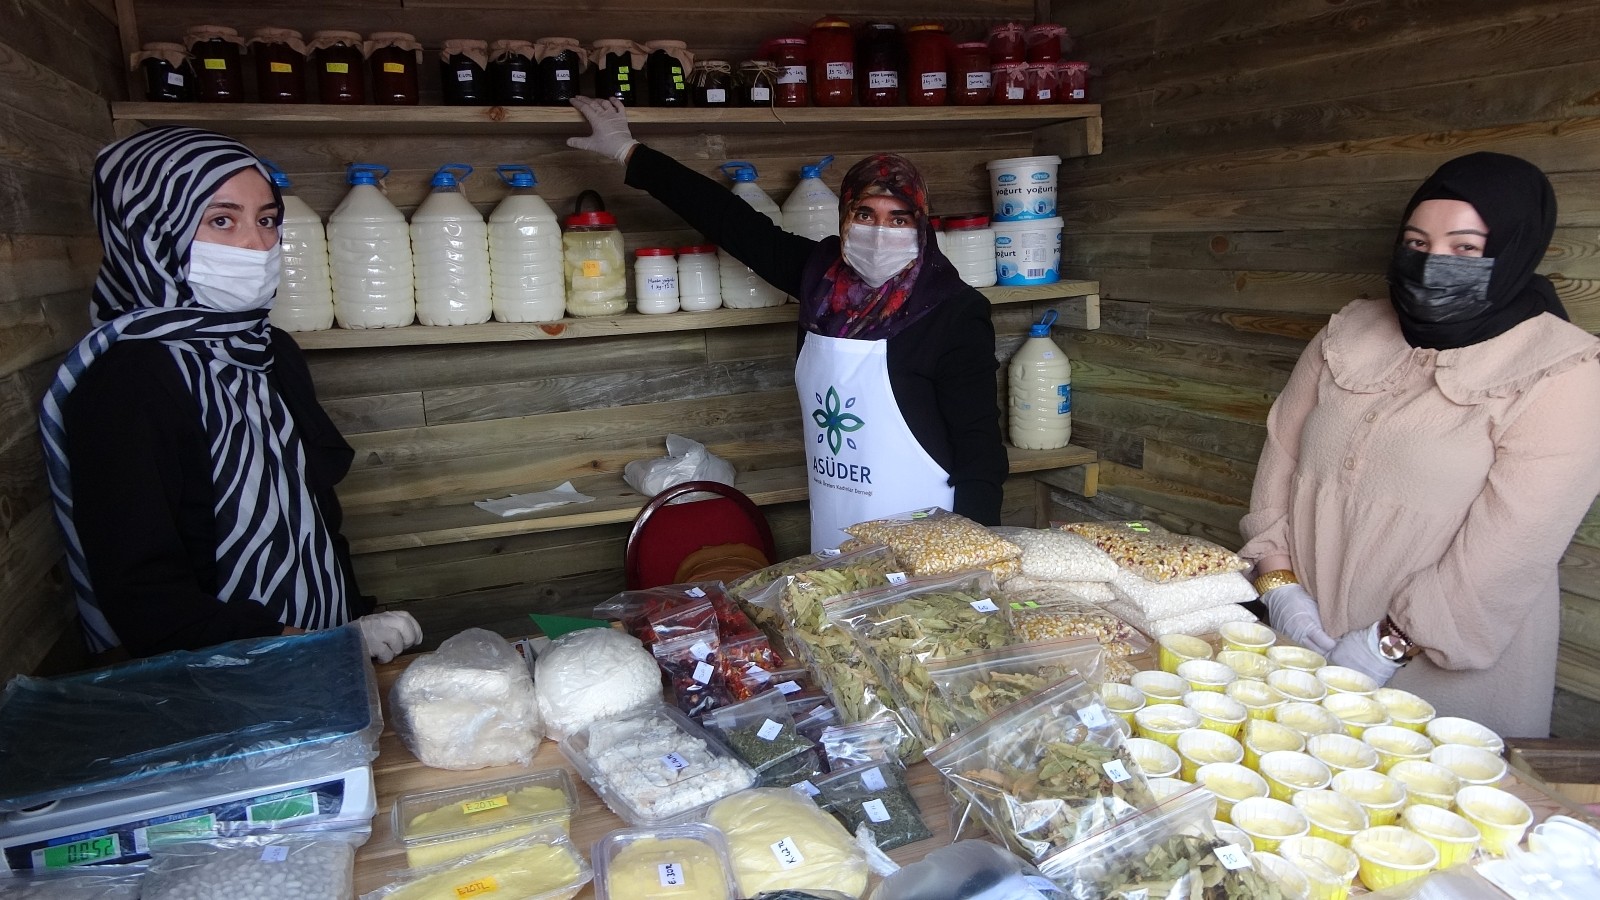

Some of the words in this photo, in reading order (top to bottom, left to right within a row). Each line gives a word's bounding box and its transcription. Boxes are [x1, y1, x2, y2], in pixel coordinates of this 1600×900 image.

[996, 187, 1022, 196] yoğurt
[995, 249, 1016, 258] oğurt
[813, 456, 872, 484] ASÜDER
